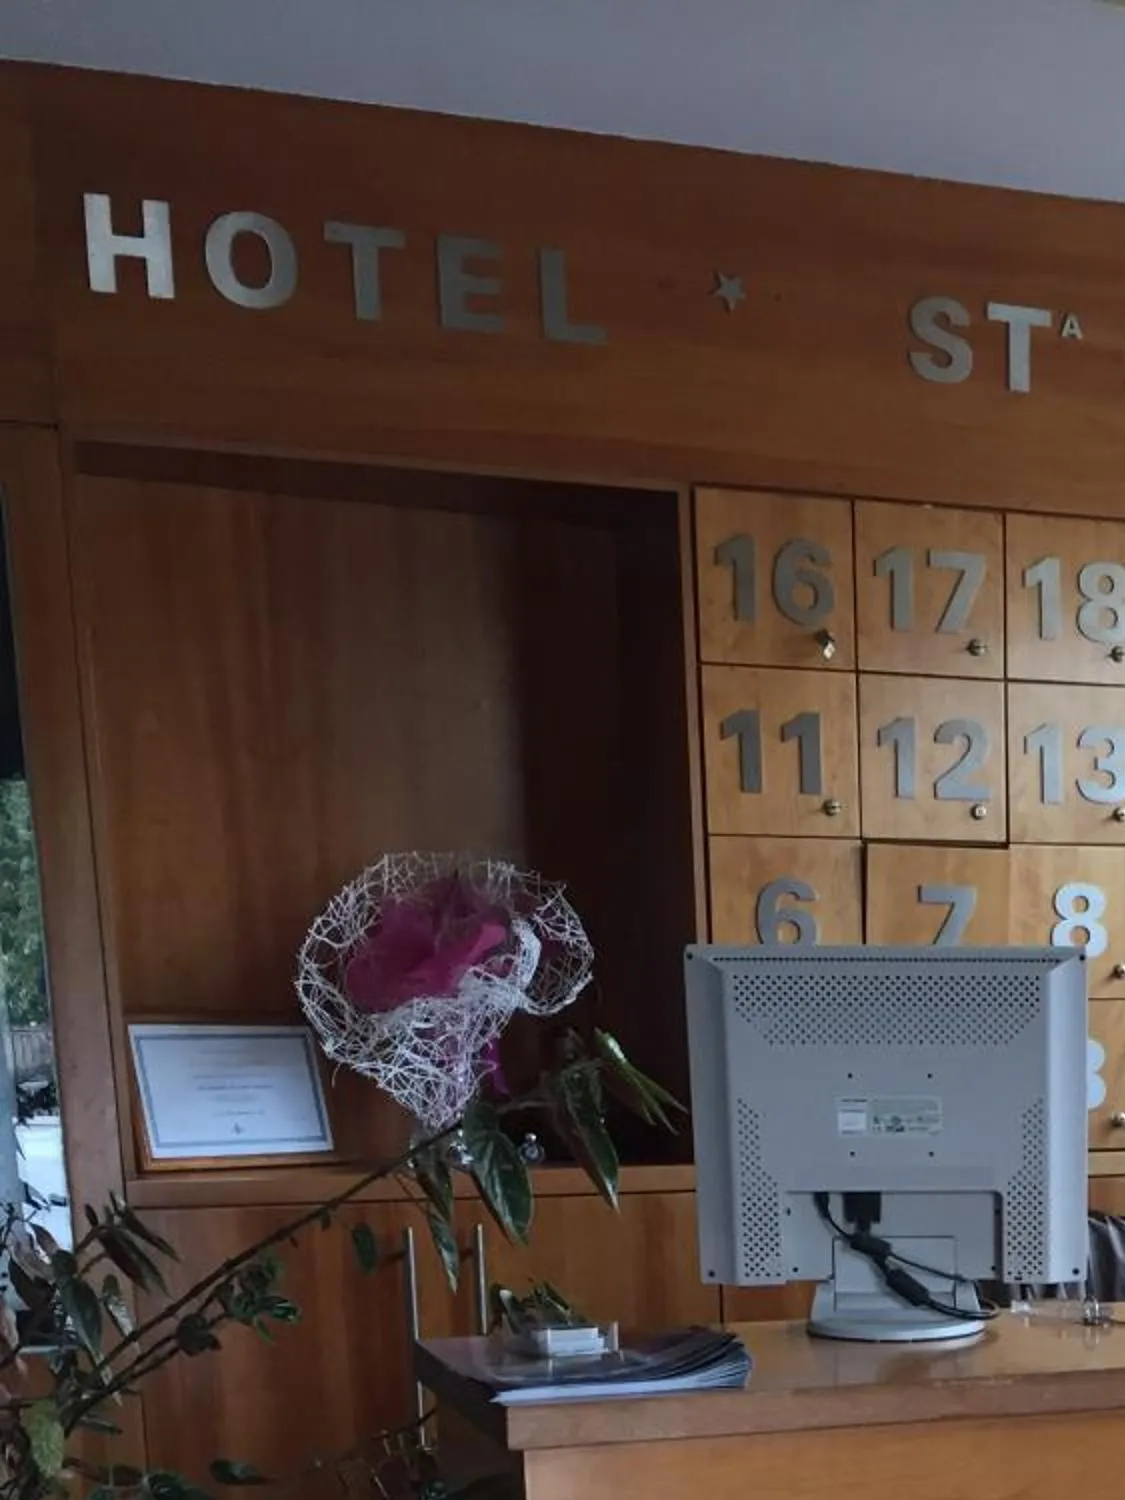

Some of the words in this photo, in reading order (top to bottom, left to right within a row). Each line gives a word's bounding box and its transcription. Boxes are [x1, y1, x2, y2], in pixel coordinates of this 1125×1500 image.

[84, 193, 607, 346] HOTEL
[714, 534, 835, 628] 16
[873, 546, 989, 633] 17
[720, 709, 822, 795] 11
[877, 717, 992, 800] 12
[755, 877, 819, 947] 6
[917, 884, 978, 947] 7
[1050, 881, 1108, 959] 8
